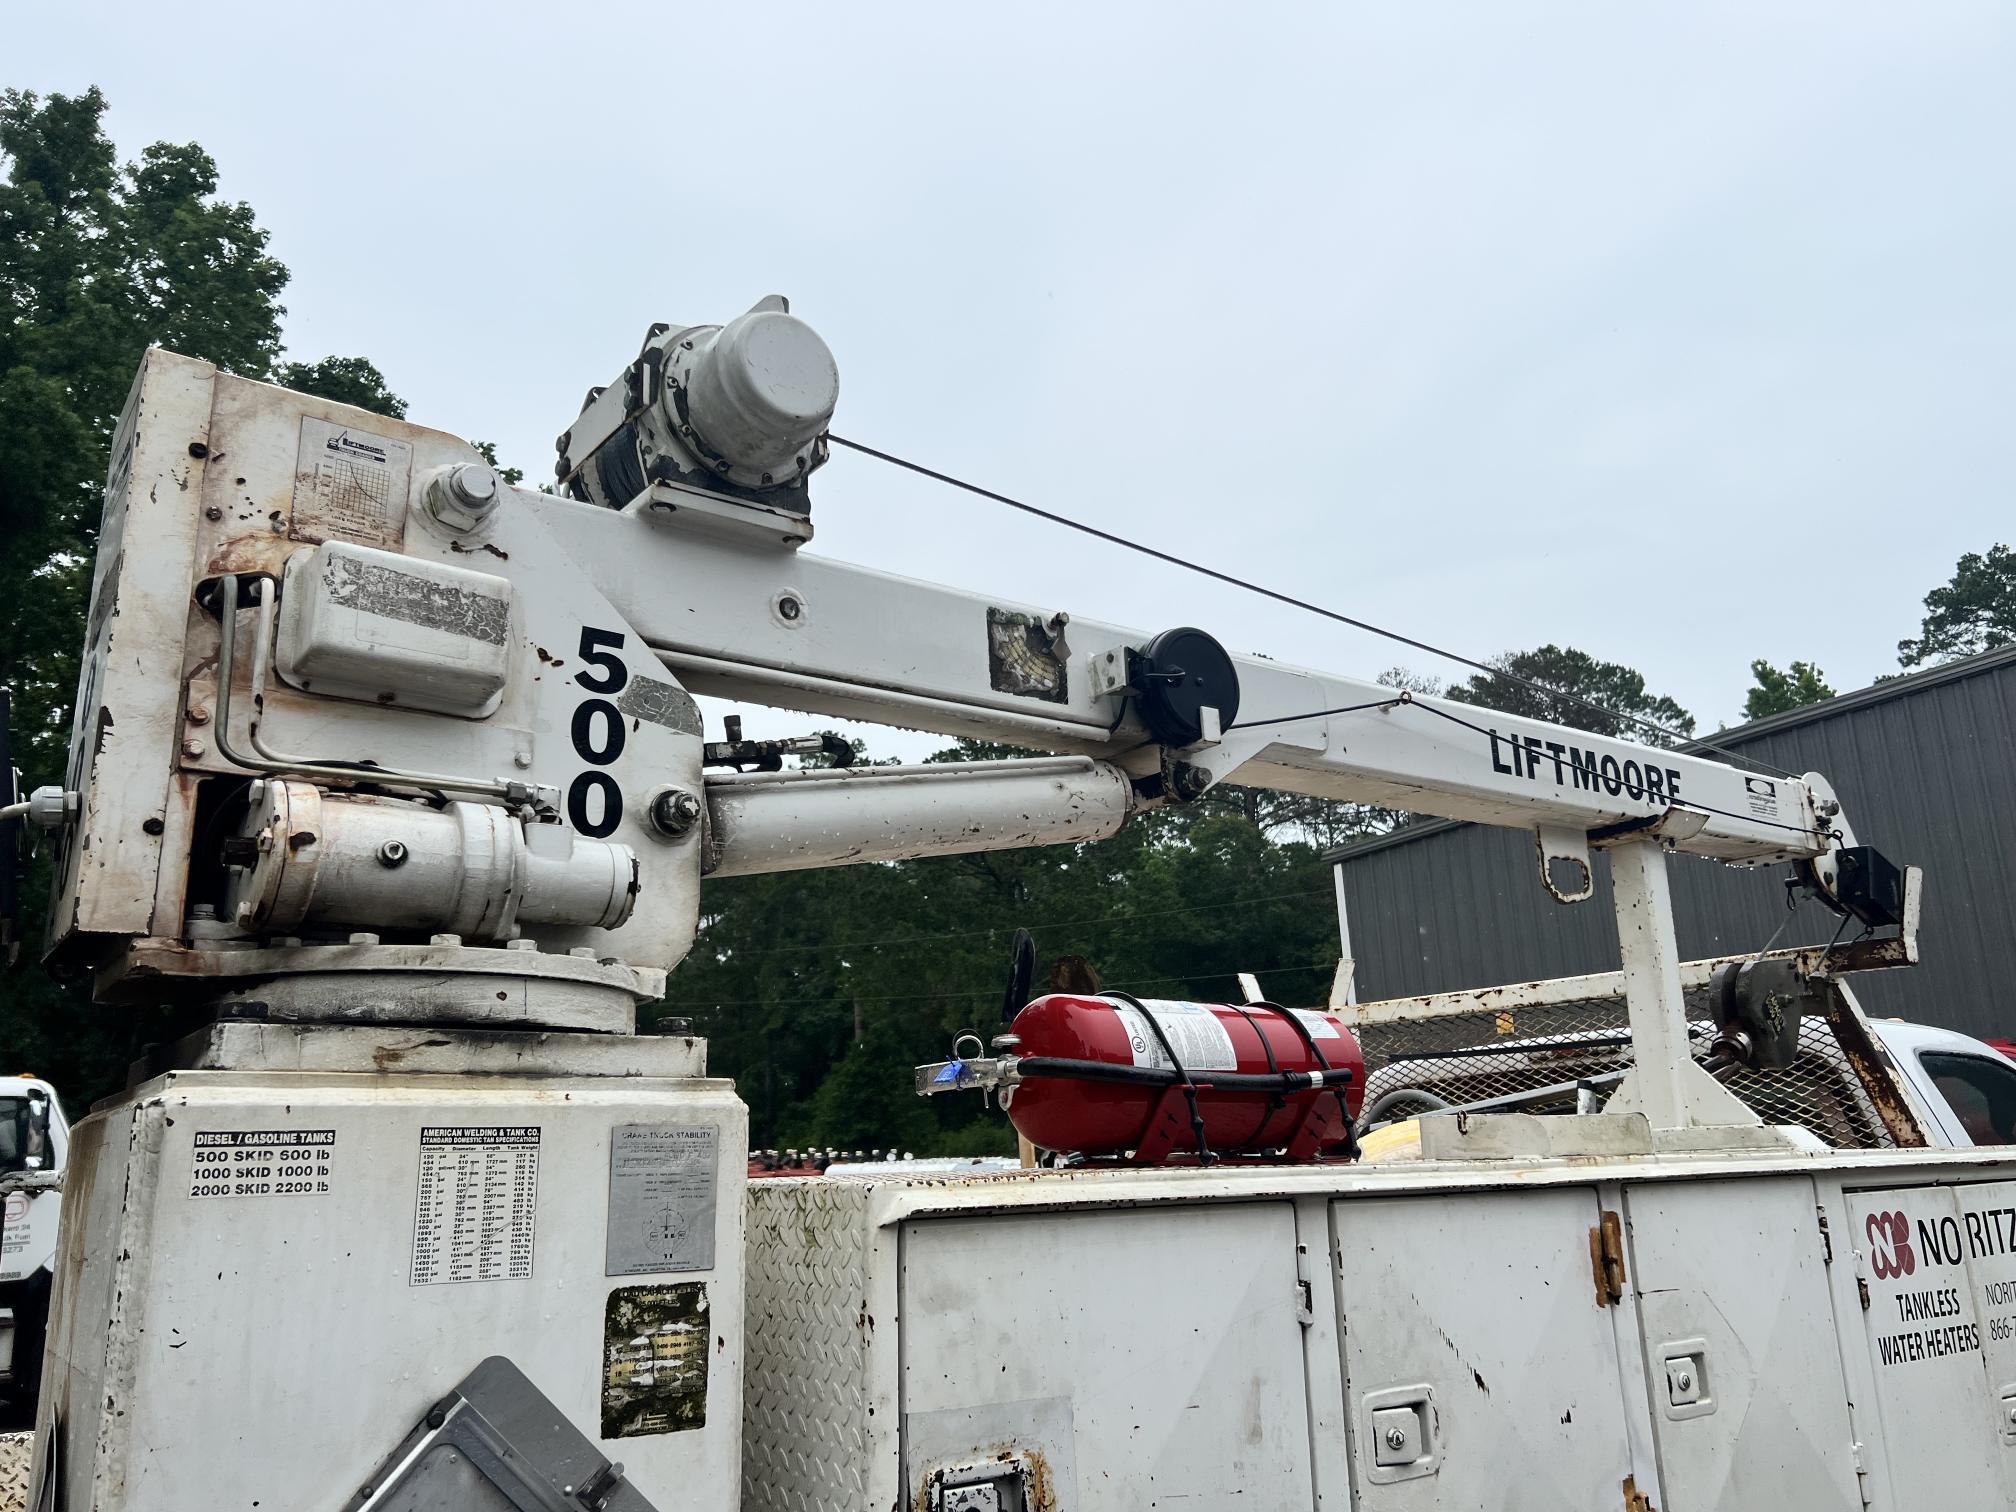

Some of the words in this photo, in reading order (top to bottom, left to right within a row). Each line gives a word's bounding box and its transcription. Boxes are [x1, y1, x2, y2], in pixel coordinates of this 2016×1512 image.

[567, 625, 628, 839] 500
[1489, 728, 1685, 806] LIFTMOORE
[196, 1134, 234, 1145] DIESEL
[236, 1134, 243, 1145] /
[244, 1133, 297, 1144] GASOLINE
[299, 1132, 334, 1143] TANKS
[423, 1129, 462, 1137] AMERICAN
[464, 1129, 498, 1137] WELDING
[507, 1128, 526, 1136] TANK
[527, 1128, 539, 1136] CO.
[676, 1131, 711, 1139] STABILITY
[195, 1151, 228, 1162] 500
[234, 1150, 274, 1162] SKID
[279, 1150, 312, 1161] 600
[316, 1149, 330, 1160] lb
[193, 1168, 231, 1179] 1000
[236, 1167, 271, 1178] SKID
[277, 1166, 313, 1177] 1000
[317, 1166, 329, 1176] lb
[191, 1184, 231, 1196] 2000
[235, 1183, 270, 1194] SKID
[275, 1182, 313, 1193] 2200
[316, 1181, 329, 1192] lb
[1917, 1208, 2016, 1267] NORITZ
[1895, 1288, 1960, 1322] TANKLESS
[1878, 1332, 1926, 1366] WATER
[1924, 1323, 1980, 1359] HEATERS
